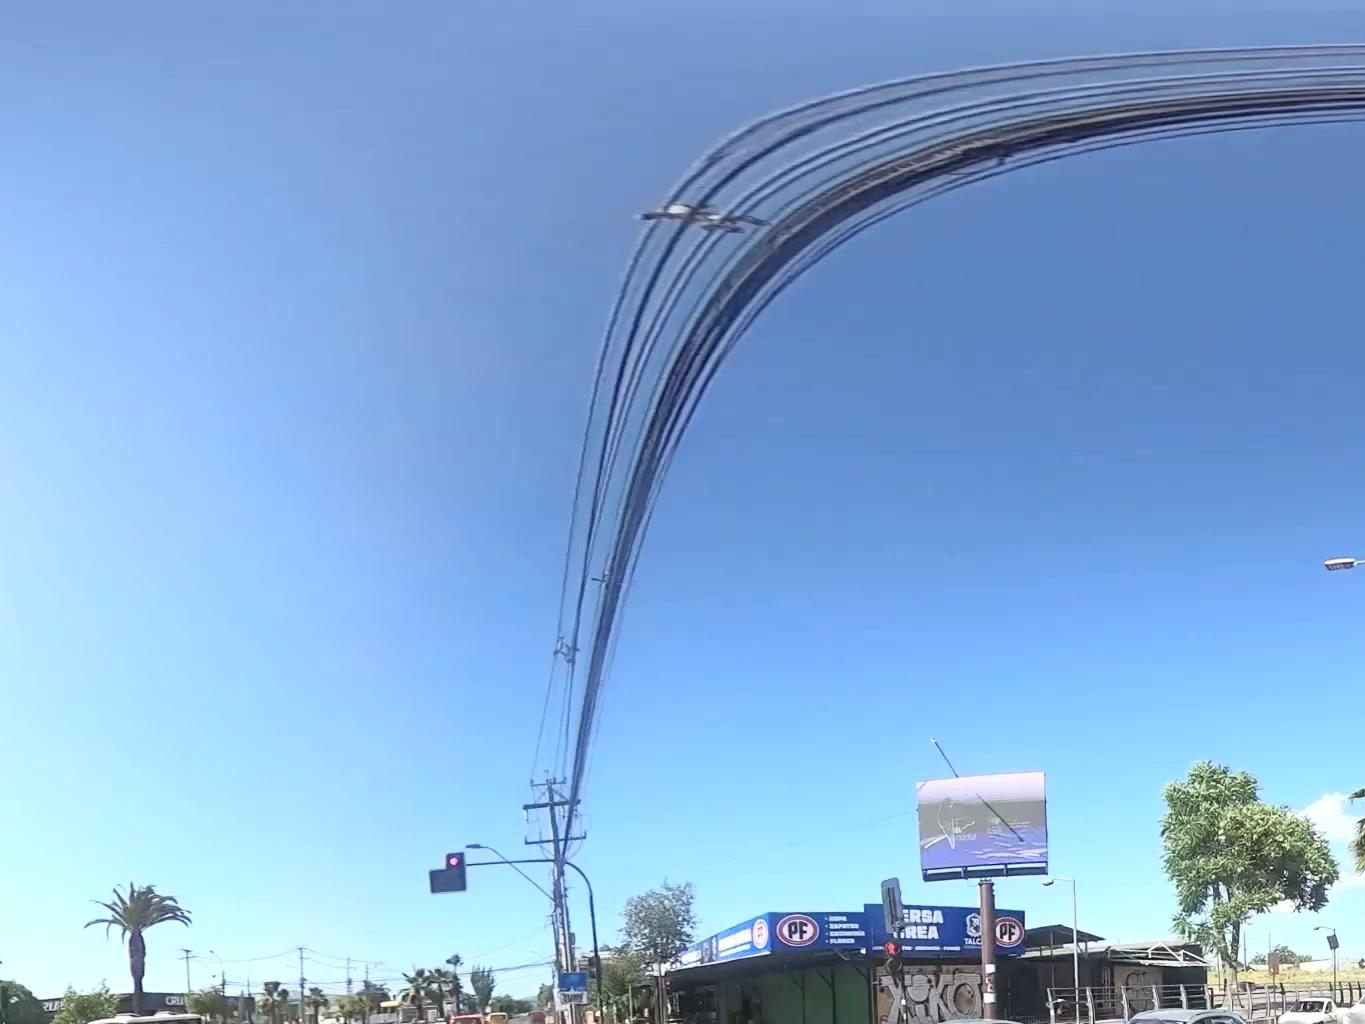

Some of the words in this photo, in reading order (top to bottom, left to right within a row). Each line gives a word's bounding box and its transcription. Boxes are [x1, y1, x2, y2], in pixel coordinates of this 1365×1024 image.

[902, 908, 944, 924] ERSA
[787, 921, 808, 940] PF
[1000, 923, 1016, 941] PF
